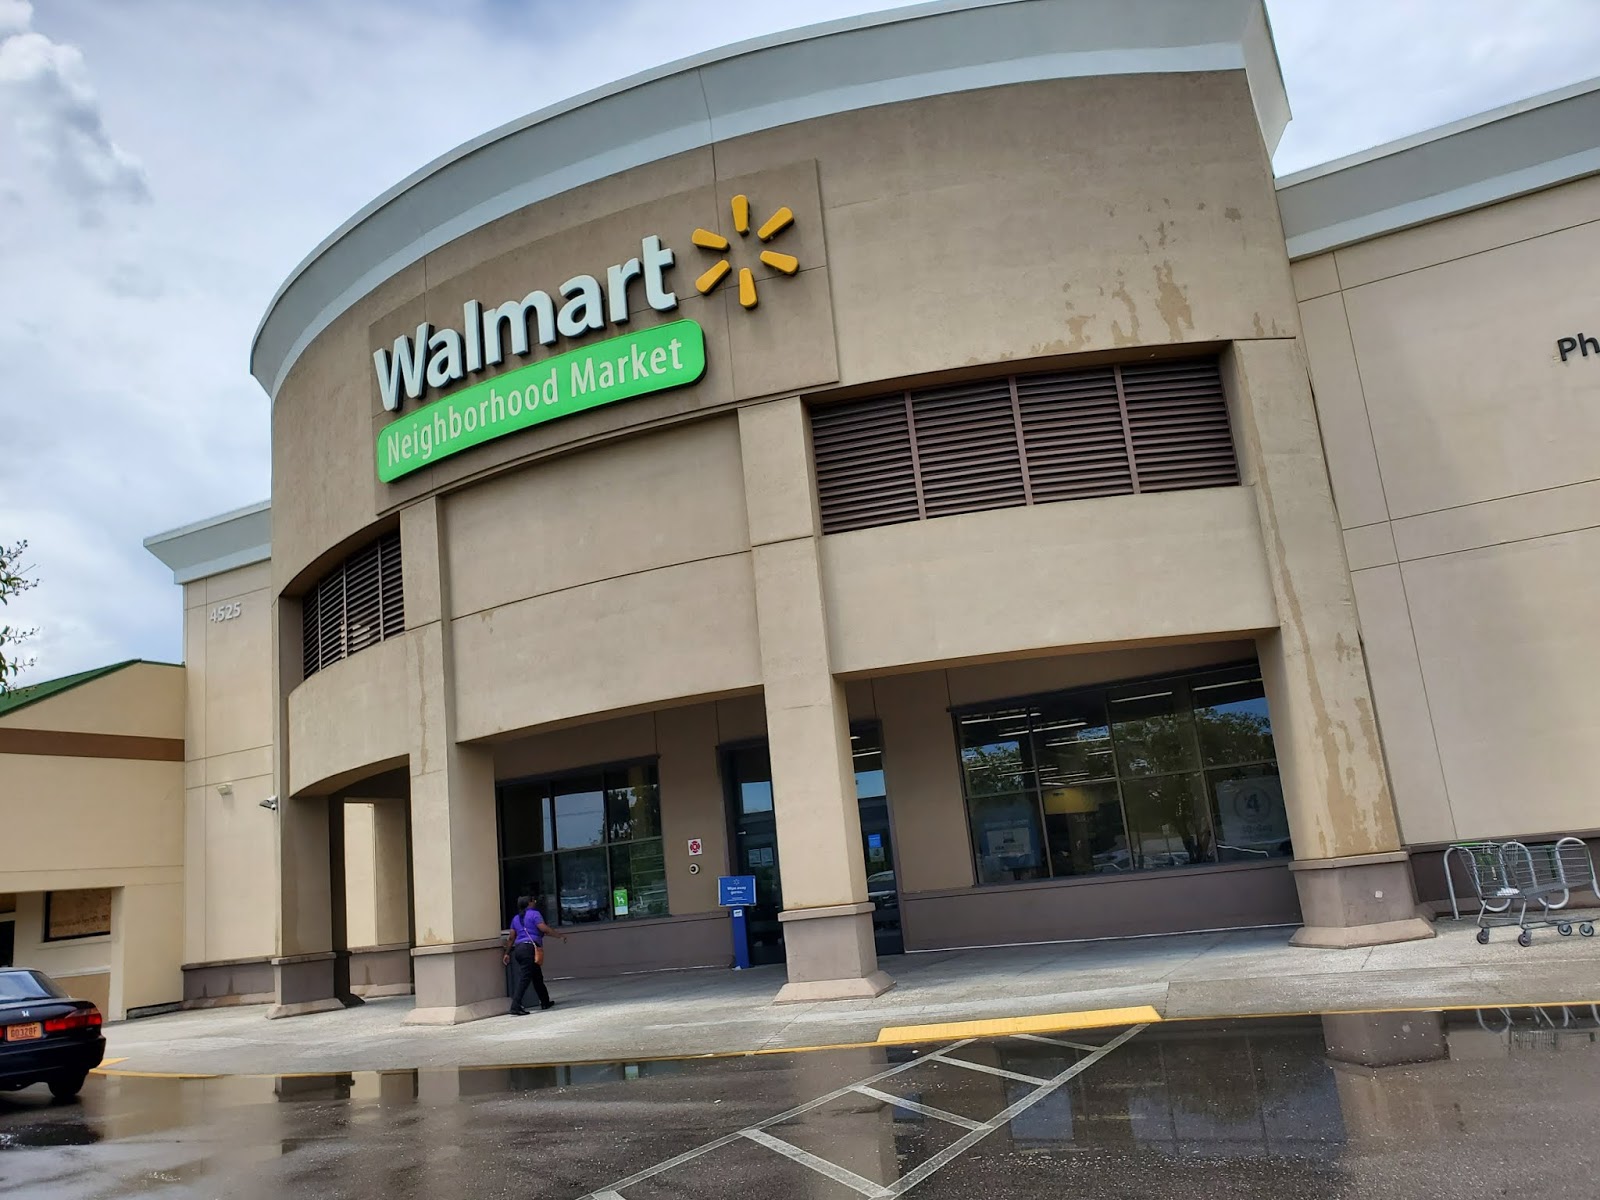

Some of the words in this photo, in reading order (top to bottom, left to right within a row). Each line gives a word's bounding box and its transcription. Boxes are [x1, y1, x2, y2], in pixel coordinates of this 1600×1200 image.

[373, 235, 677, 412] Walmart
[387, 367, 559, 467] Neighborhood
[571, 338, 683, 398] Market
[210, 601, 241, 622] 4525
